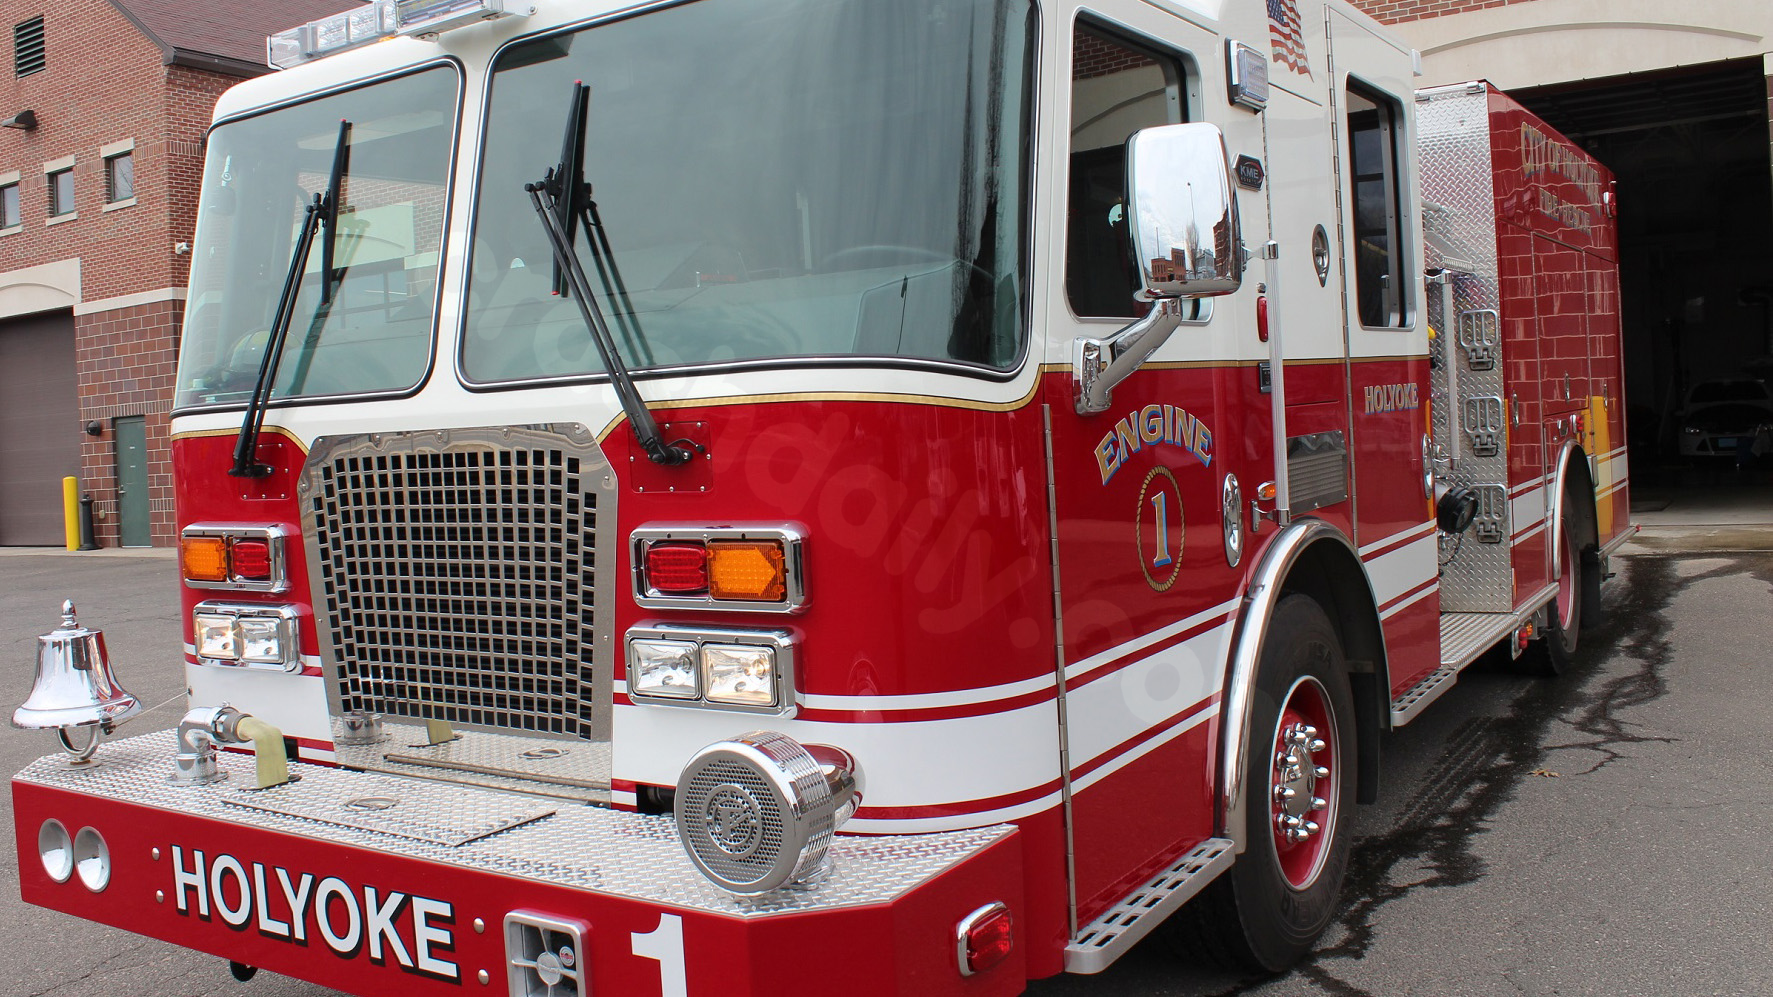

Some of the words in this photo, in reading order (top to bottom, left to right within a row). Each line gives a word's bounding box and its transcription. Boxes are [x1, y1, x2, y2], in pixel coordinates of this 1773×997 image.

[1240, 165, 1259, 179] KME
[1364, 382, 1419, 415] HOLYOKE
[1094, 404, 1213, 486] ENGINE
[1151, 490, 1172, 568] 1
[171, 844, 463, 985] HOLYOKE
[631, 912, 688, 997] 1
